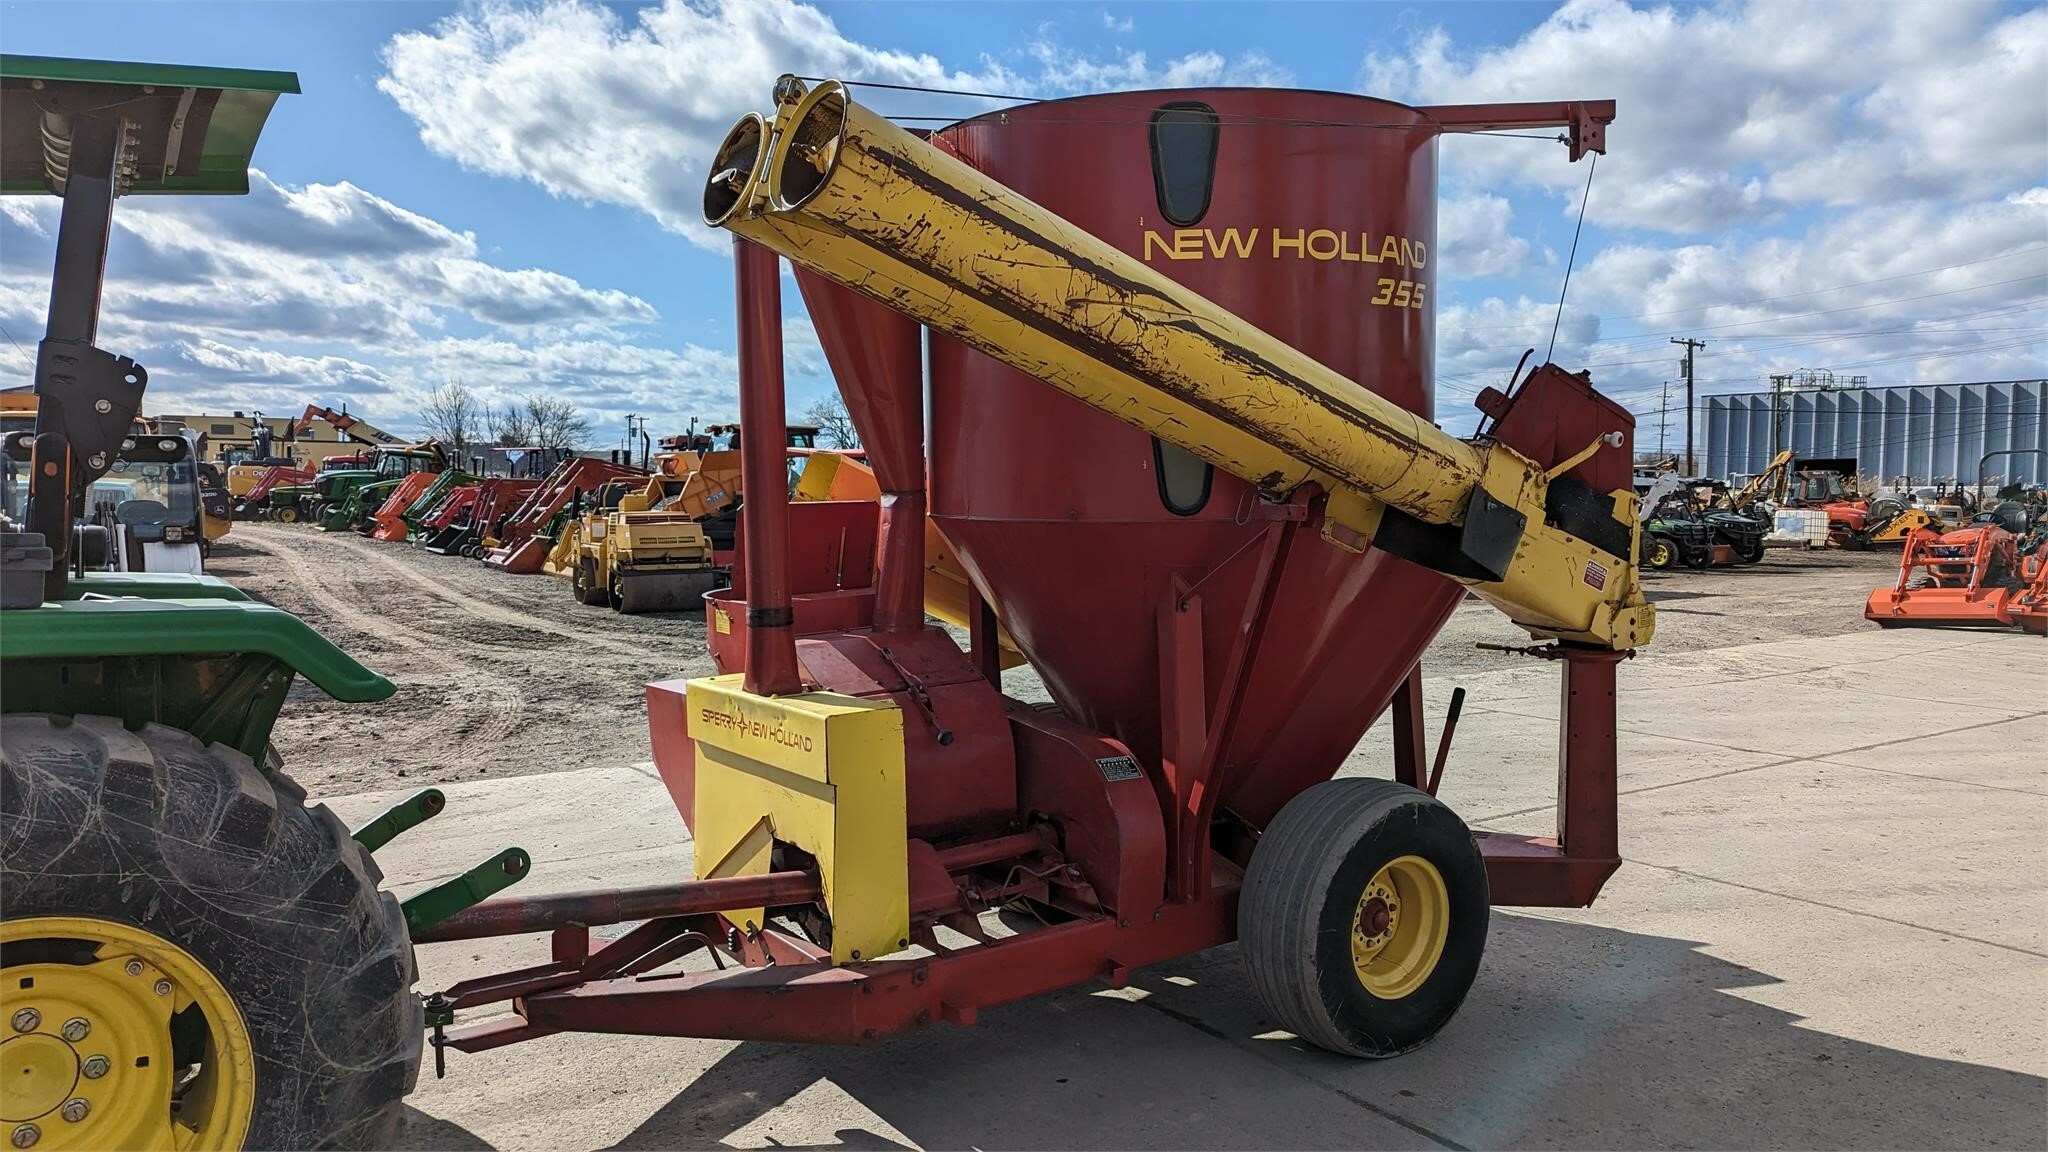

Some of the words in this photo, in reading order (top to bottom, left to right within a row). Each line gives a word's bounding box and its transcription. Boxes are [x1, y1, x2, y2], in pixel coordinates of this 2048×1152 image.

[1144, 228, 1259, 261] NEW
[1272, 228, 1427, 269] HOLLAND
[1370, 278, 1426, 309] 355
[371, 430, 394, 443] JLG
[1879, 511, 1913, 537] BOXER
[702, 708, 737, 731] SPERRY
[748, 720, 768, 739] NEW
[769, 726, 813, 752] HOLLAND
